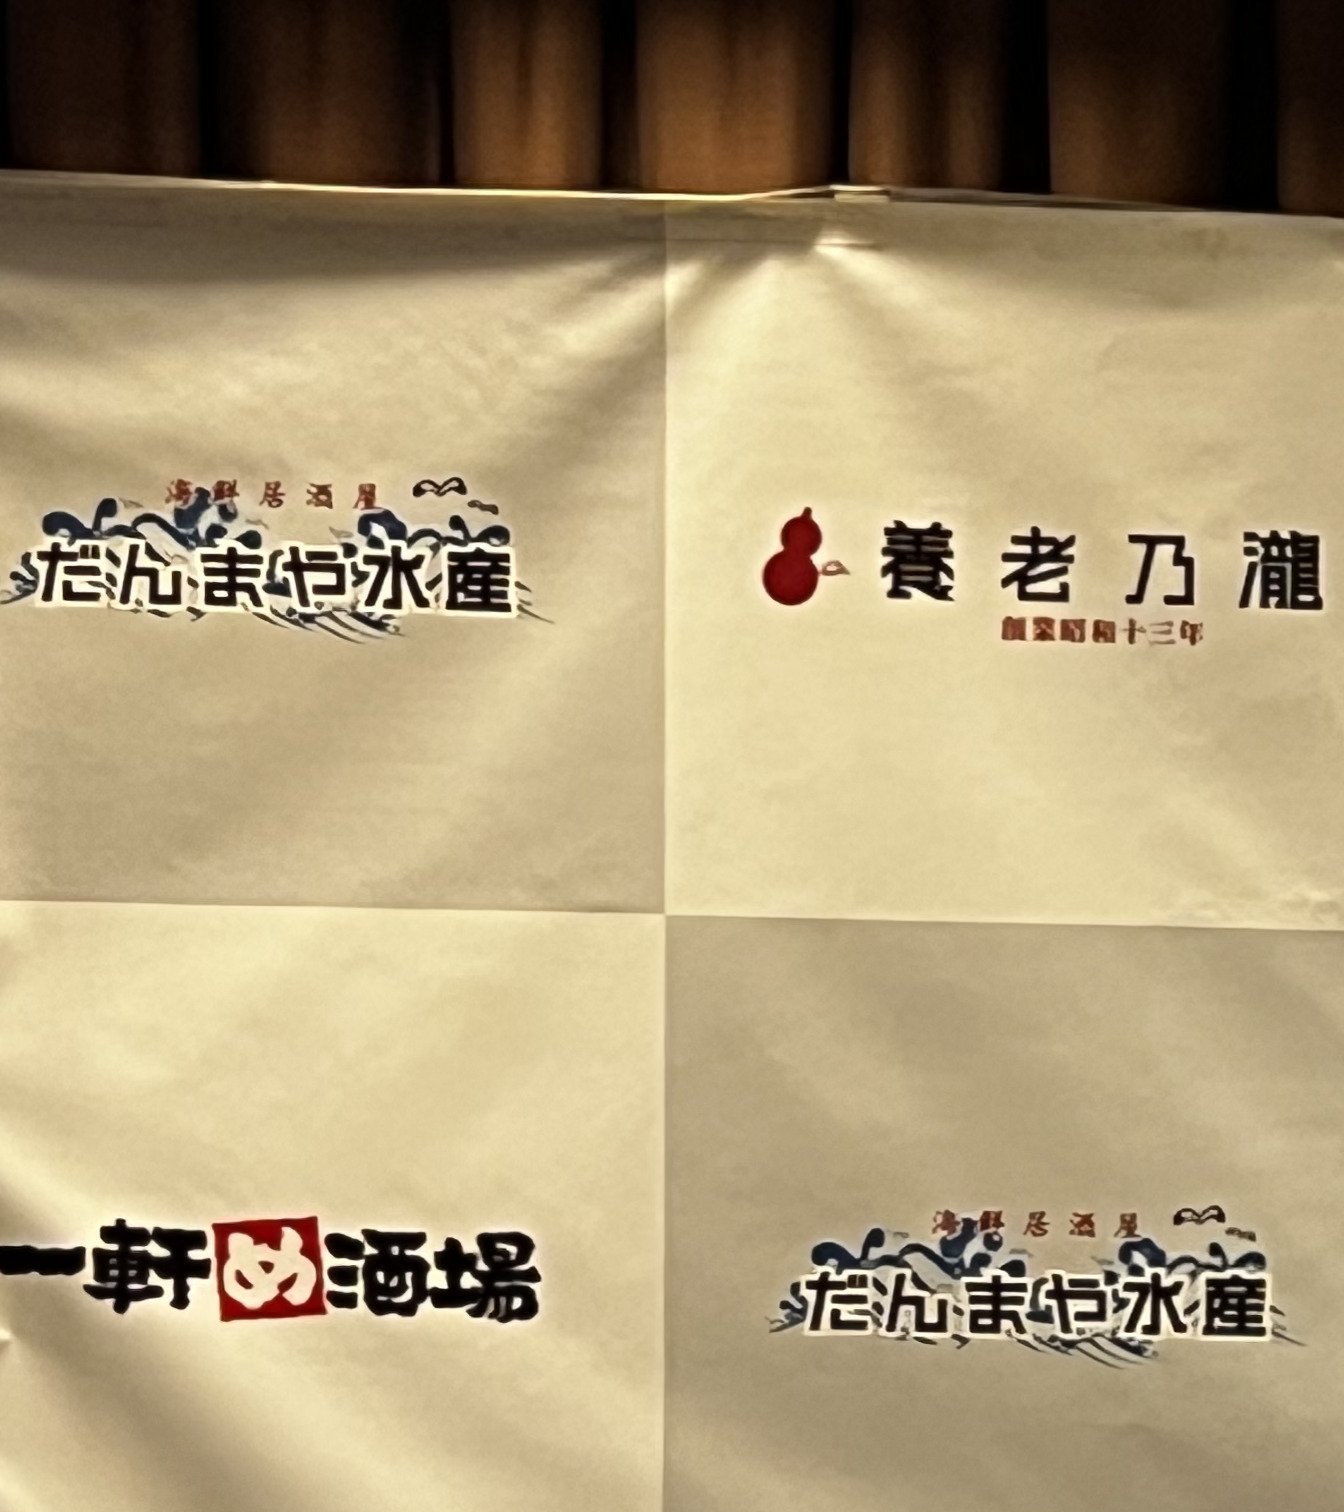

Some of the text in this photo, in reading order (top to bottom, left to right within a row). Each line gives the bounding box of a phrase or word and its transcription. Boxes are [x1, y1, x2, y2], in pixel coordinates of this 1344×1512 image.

[36, 542, 512, 614] だんまや水産
[881, 520, 1324, 611] 養老乃瀧
[0, 1216, 542, 1323] 一軒め酒場
[805, 1271, 1267, 1337] だんまや水産
